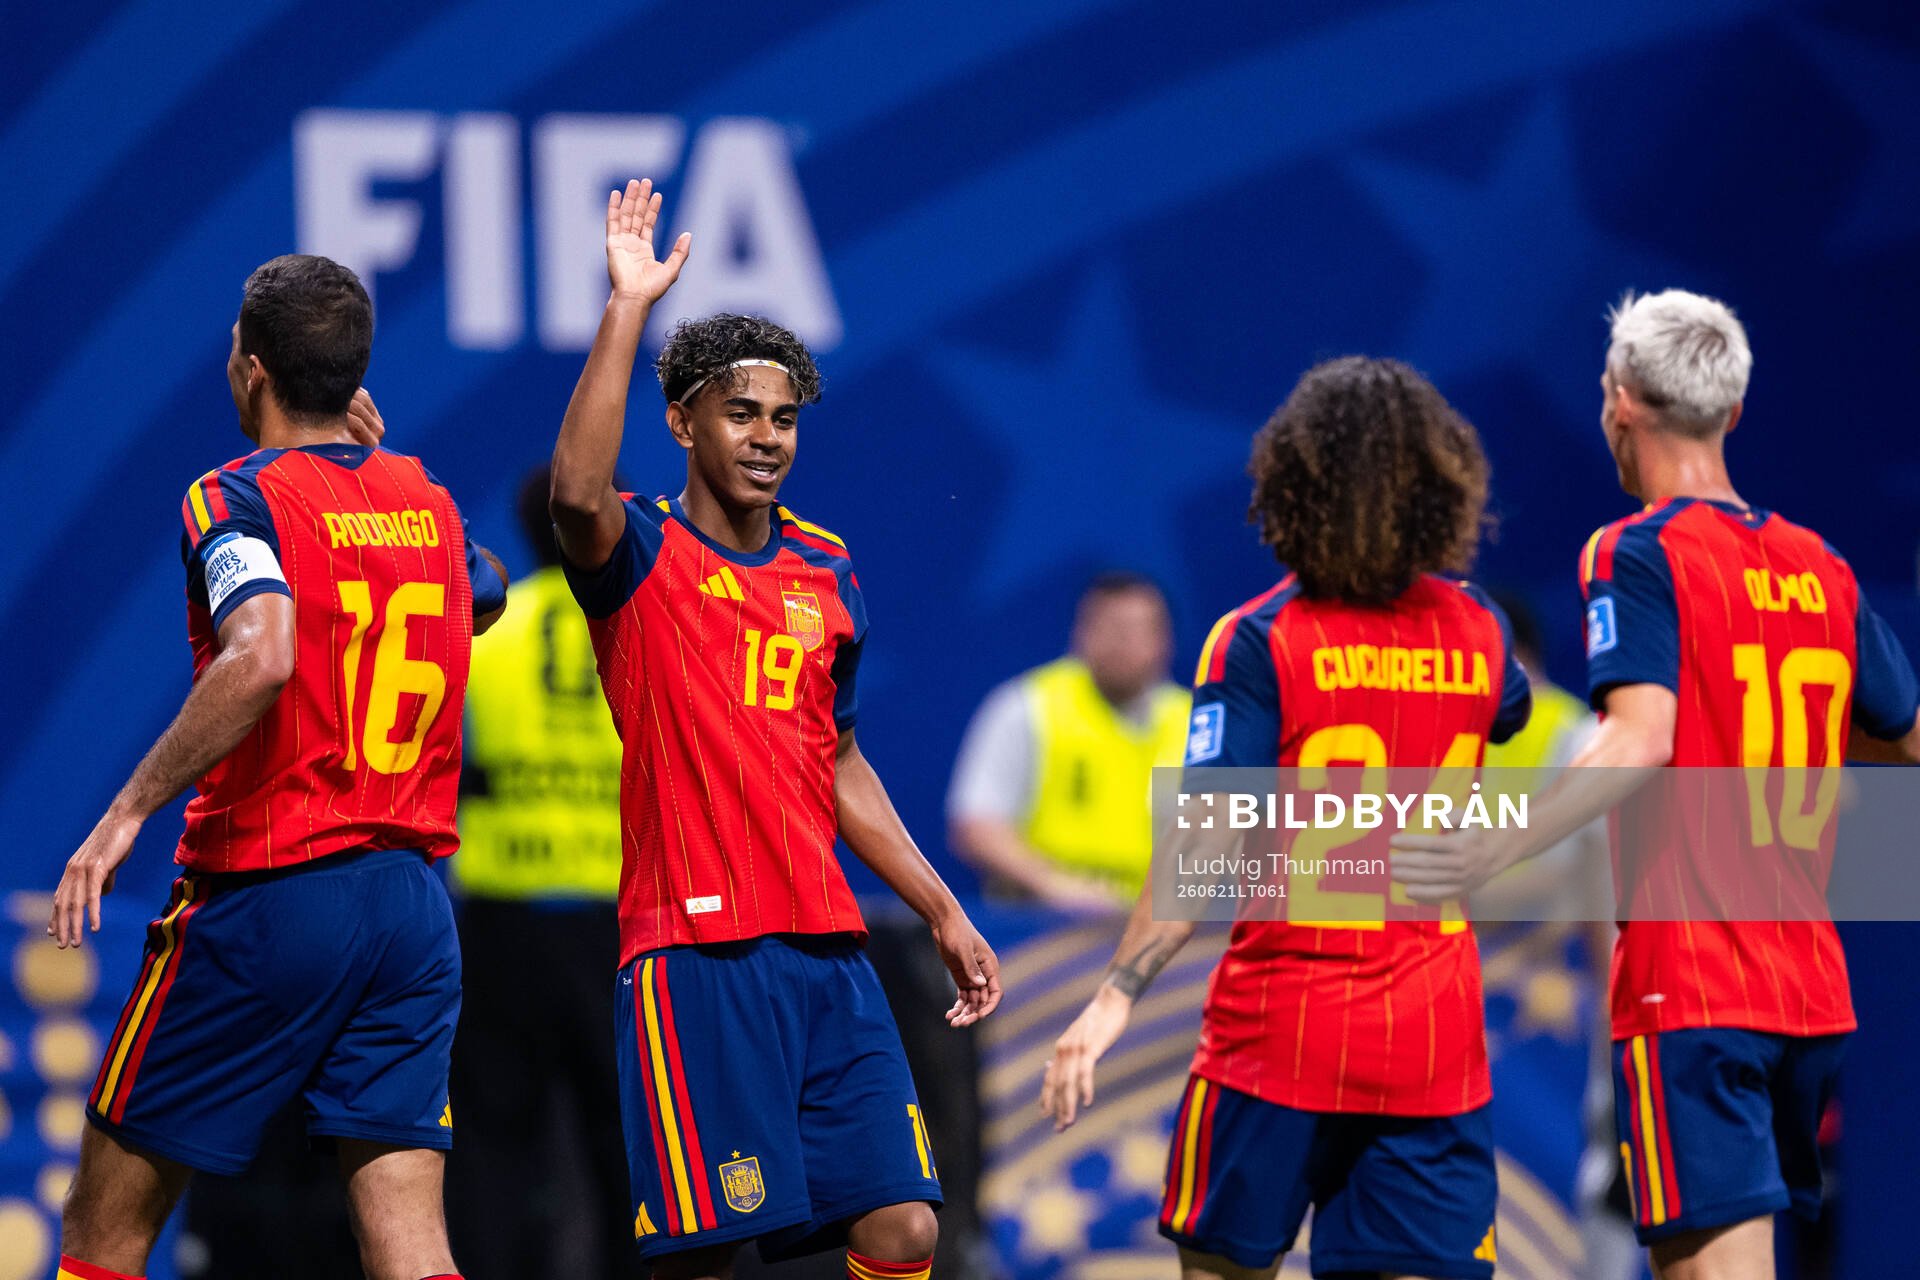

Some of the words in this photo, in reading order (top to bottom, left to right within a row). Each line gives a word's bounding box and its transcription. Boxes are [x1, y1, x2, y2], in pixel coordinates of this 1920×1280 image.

[294, 109, 843, 351] FIFA
[322, 509, 439, 549] RODRIGO
[1743, 568, 1827, 613] OLMO
[337, 580, 446, 775] 16
[744, 628, 804, 711] 19
[1312, 645, 1490, 696] CUCURELLA
[1732, 643, 1852, 851] 10
[1287, 723, 1481, 935] 24
[906, 1104, 938, 1179] 1
